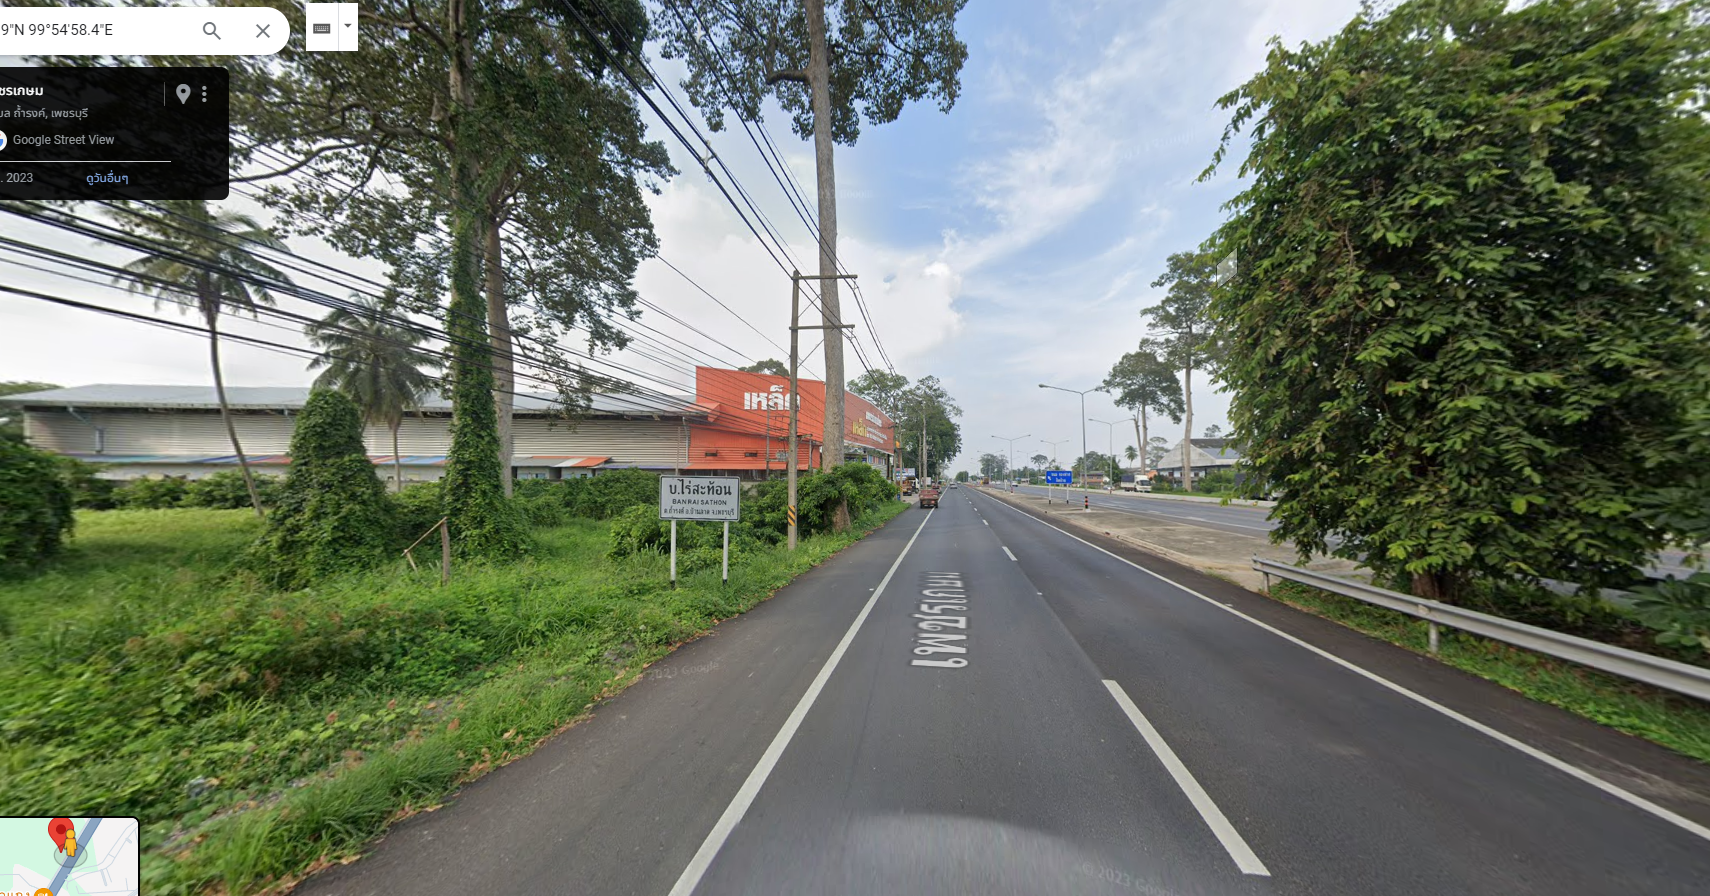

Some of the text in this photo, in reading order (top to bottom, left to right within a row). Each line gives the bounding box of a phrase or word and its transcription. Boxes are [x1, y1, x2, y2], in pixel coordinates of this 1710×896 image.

[744, 384, 801, 411] เหล็ก
[669, 479, 732, 495] บ.ไร่สะท้อน
